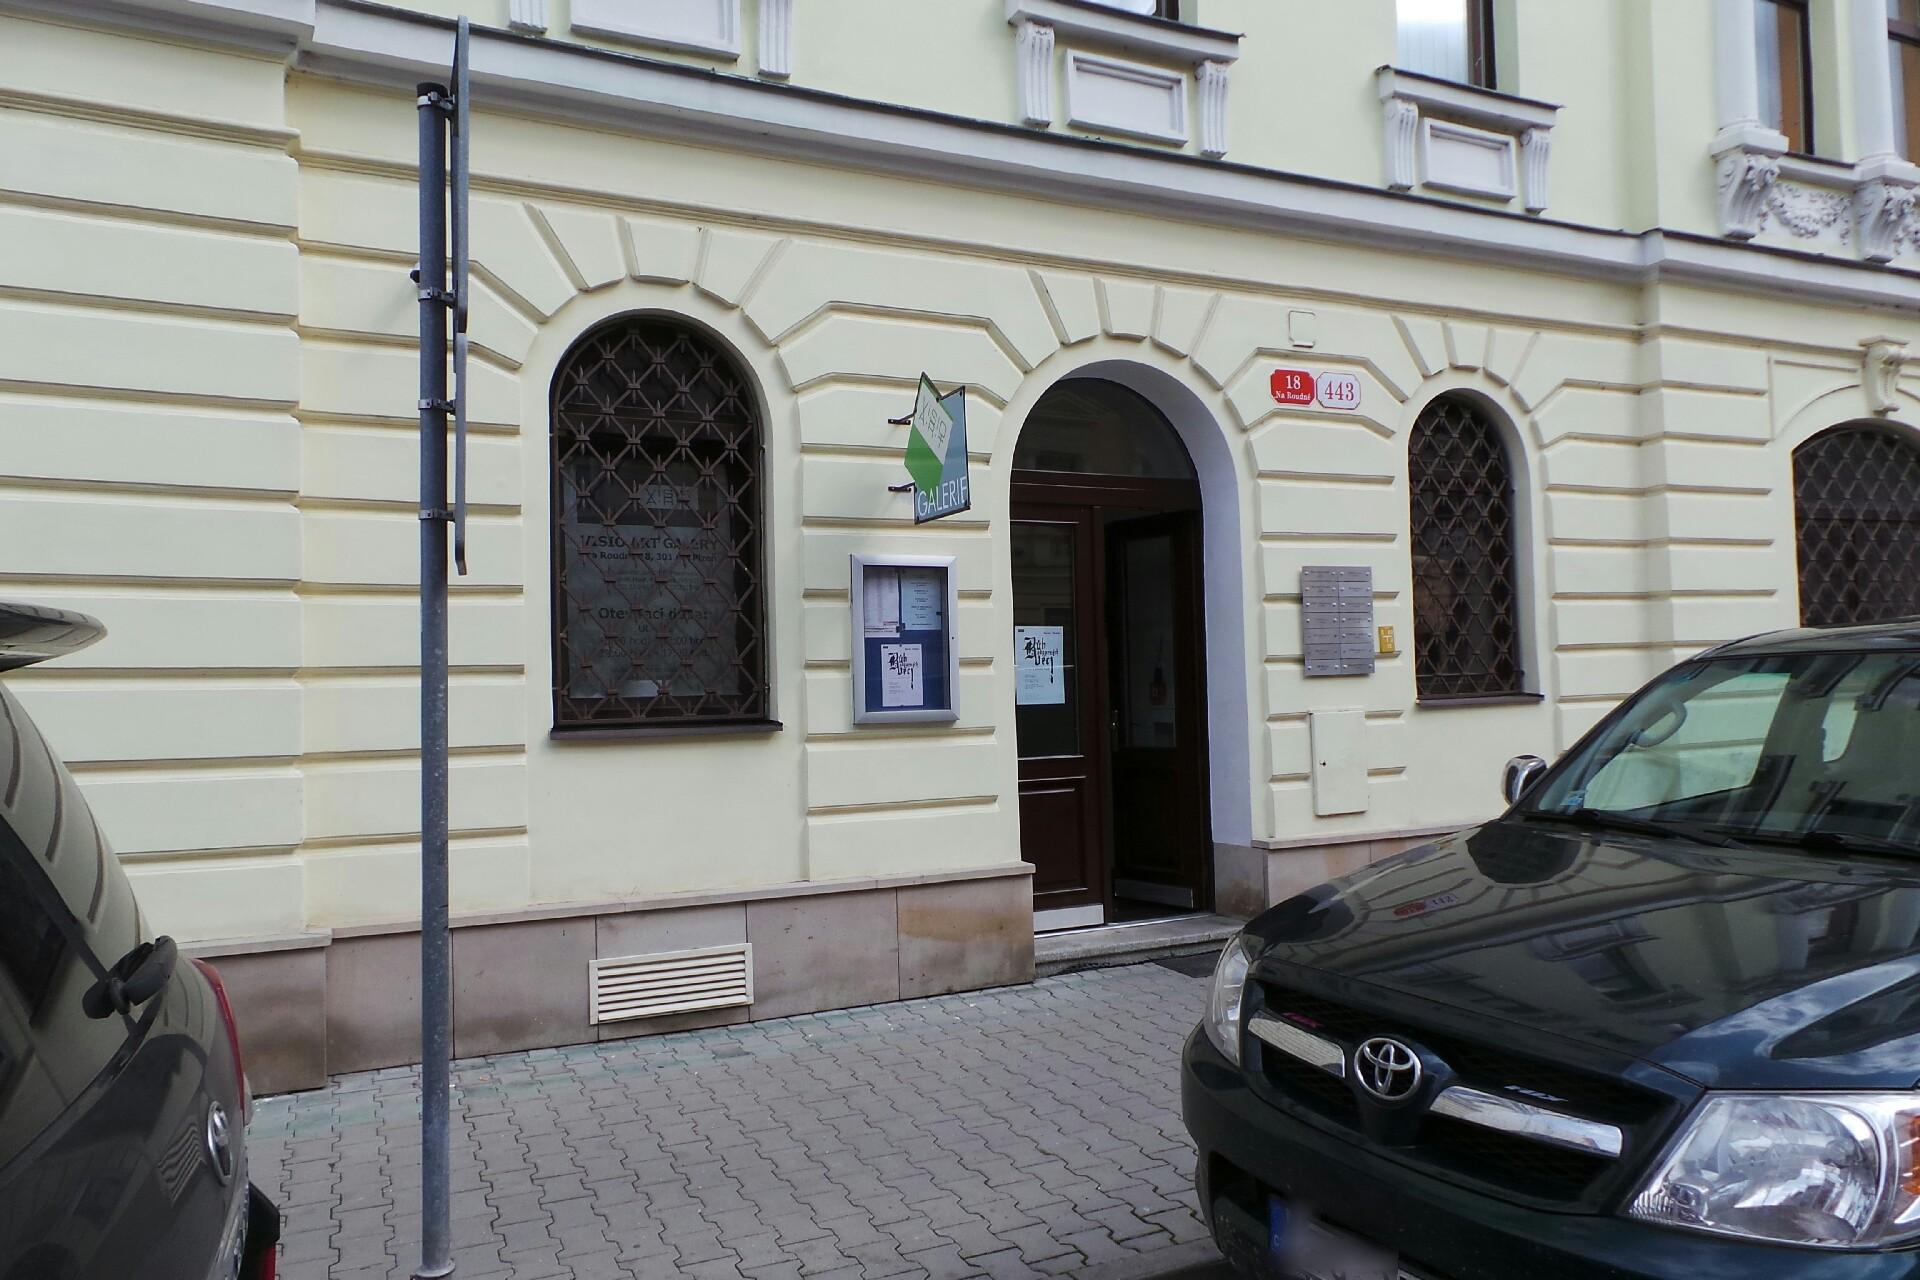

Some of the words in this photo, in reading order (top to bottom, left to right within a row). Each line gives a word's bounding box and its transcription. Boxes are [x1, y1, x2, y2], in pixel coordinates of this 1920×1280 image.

[1286, 375, 1301, 390] 18
[1325, 380, 1354, 401] 443
[1275, 390, 1285, 399] Na
[917, 476, 968, 516] GALERIE
